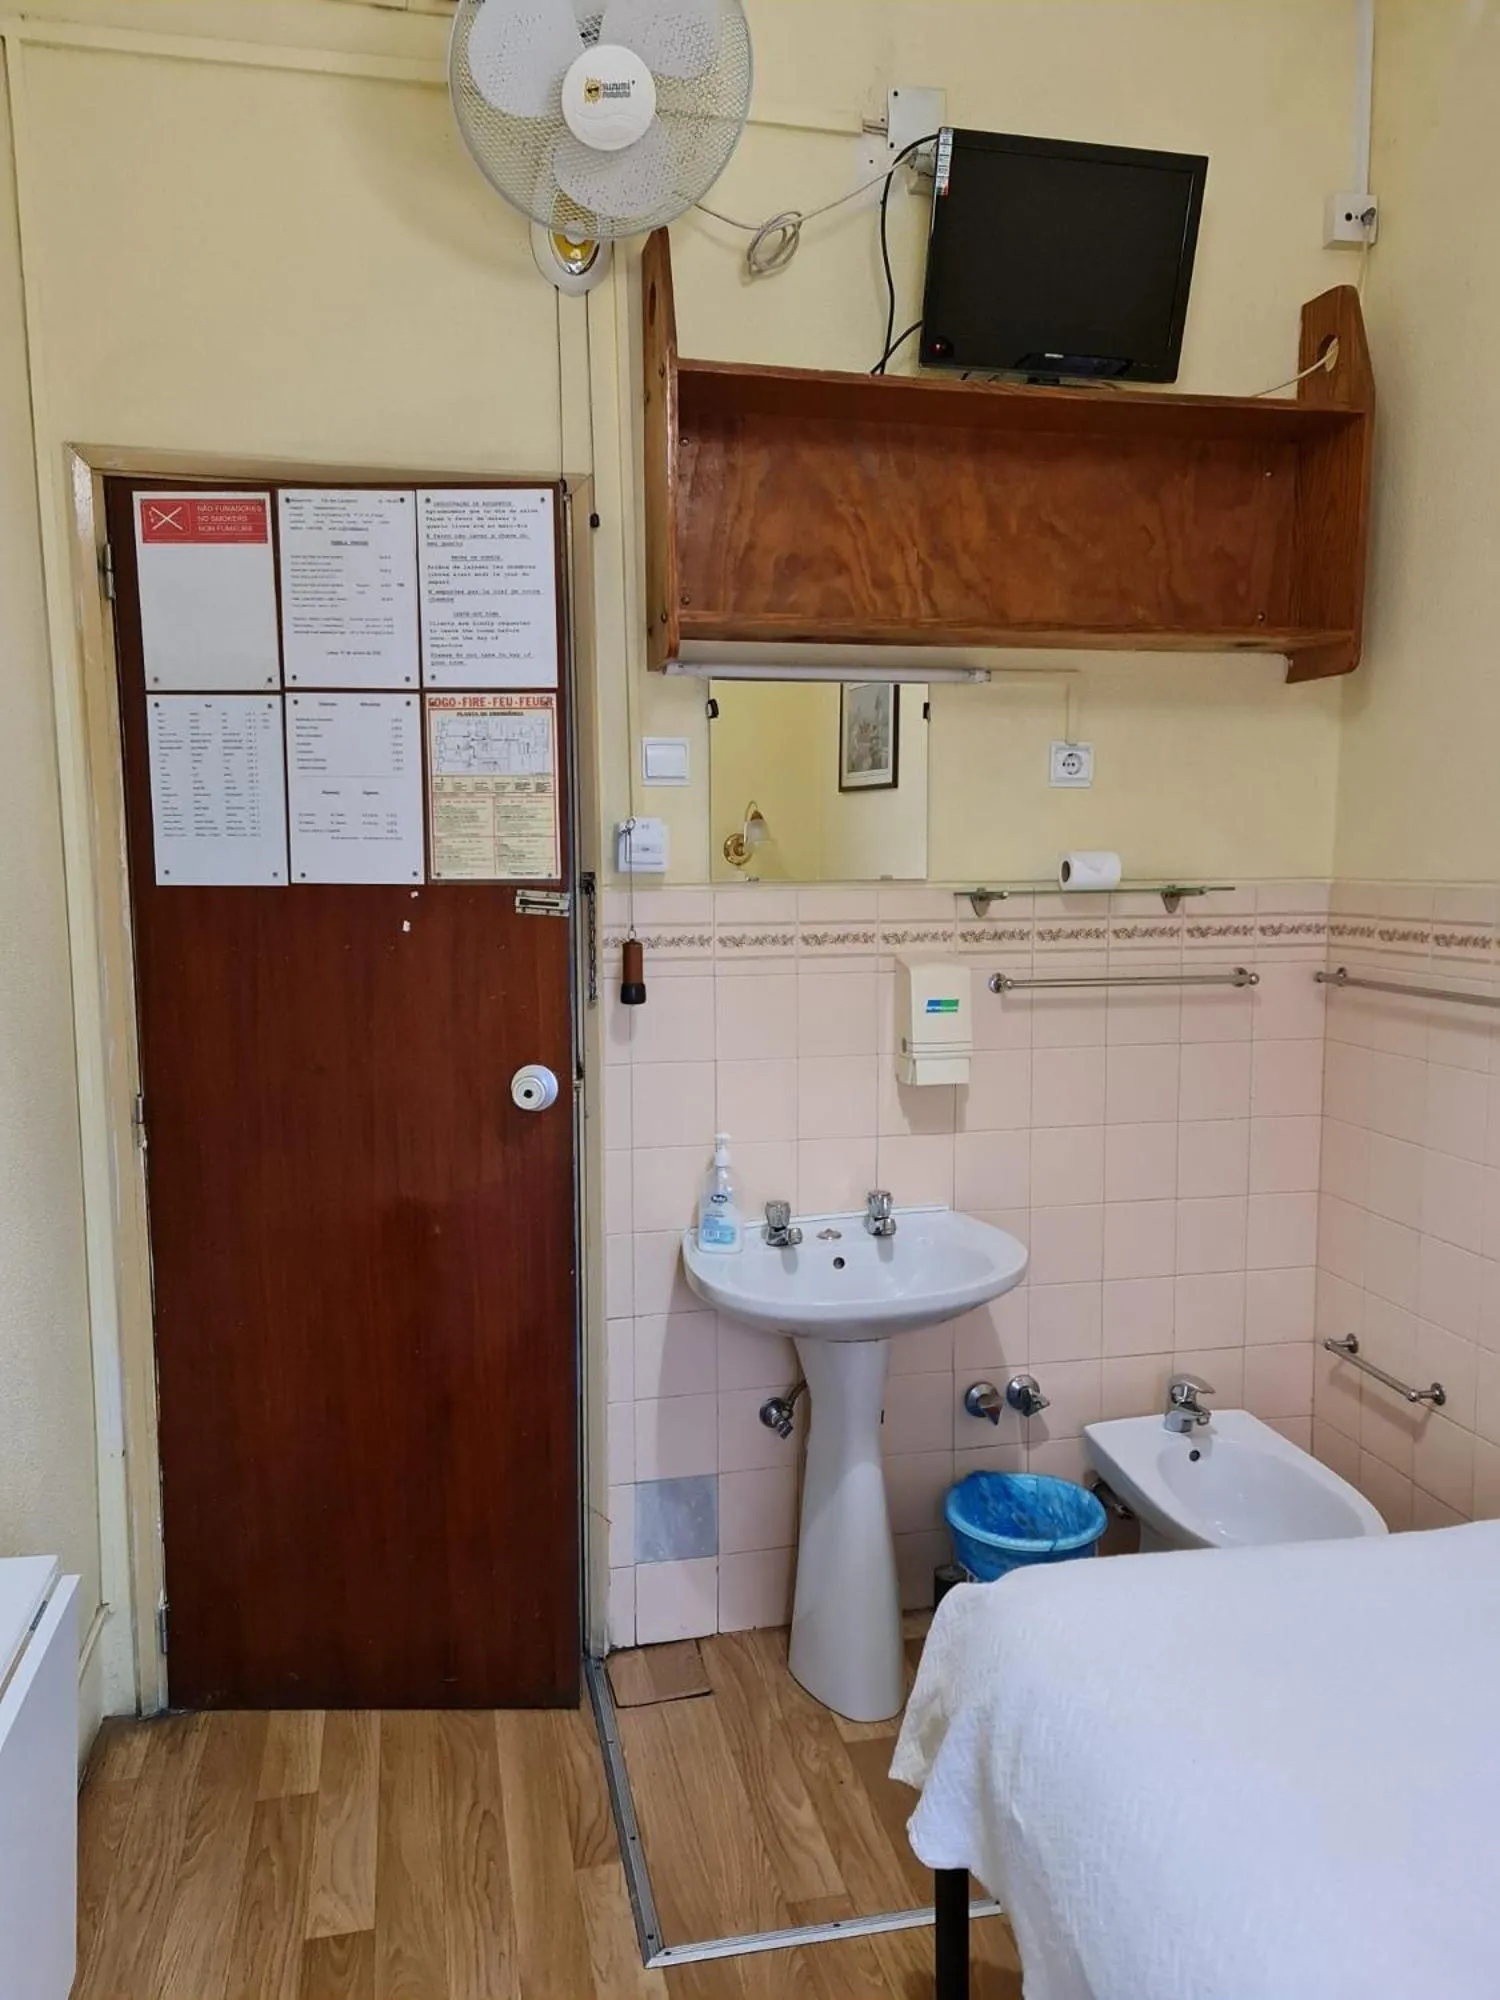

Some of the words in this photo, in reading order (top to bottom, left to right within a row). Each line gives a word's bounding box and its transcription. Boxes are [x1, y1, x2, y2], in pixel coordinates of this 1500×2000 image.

[215, 504, 262, 513] FUMADORES
[462, 696, 487, 707] FIRE
[492, 696, 513, 706] FEU
